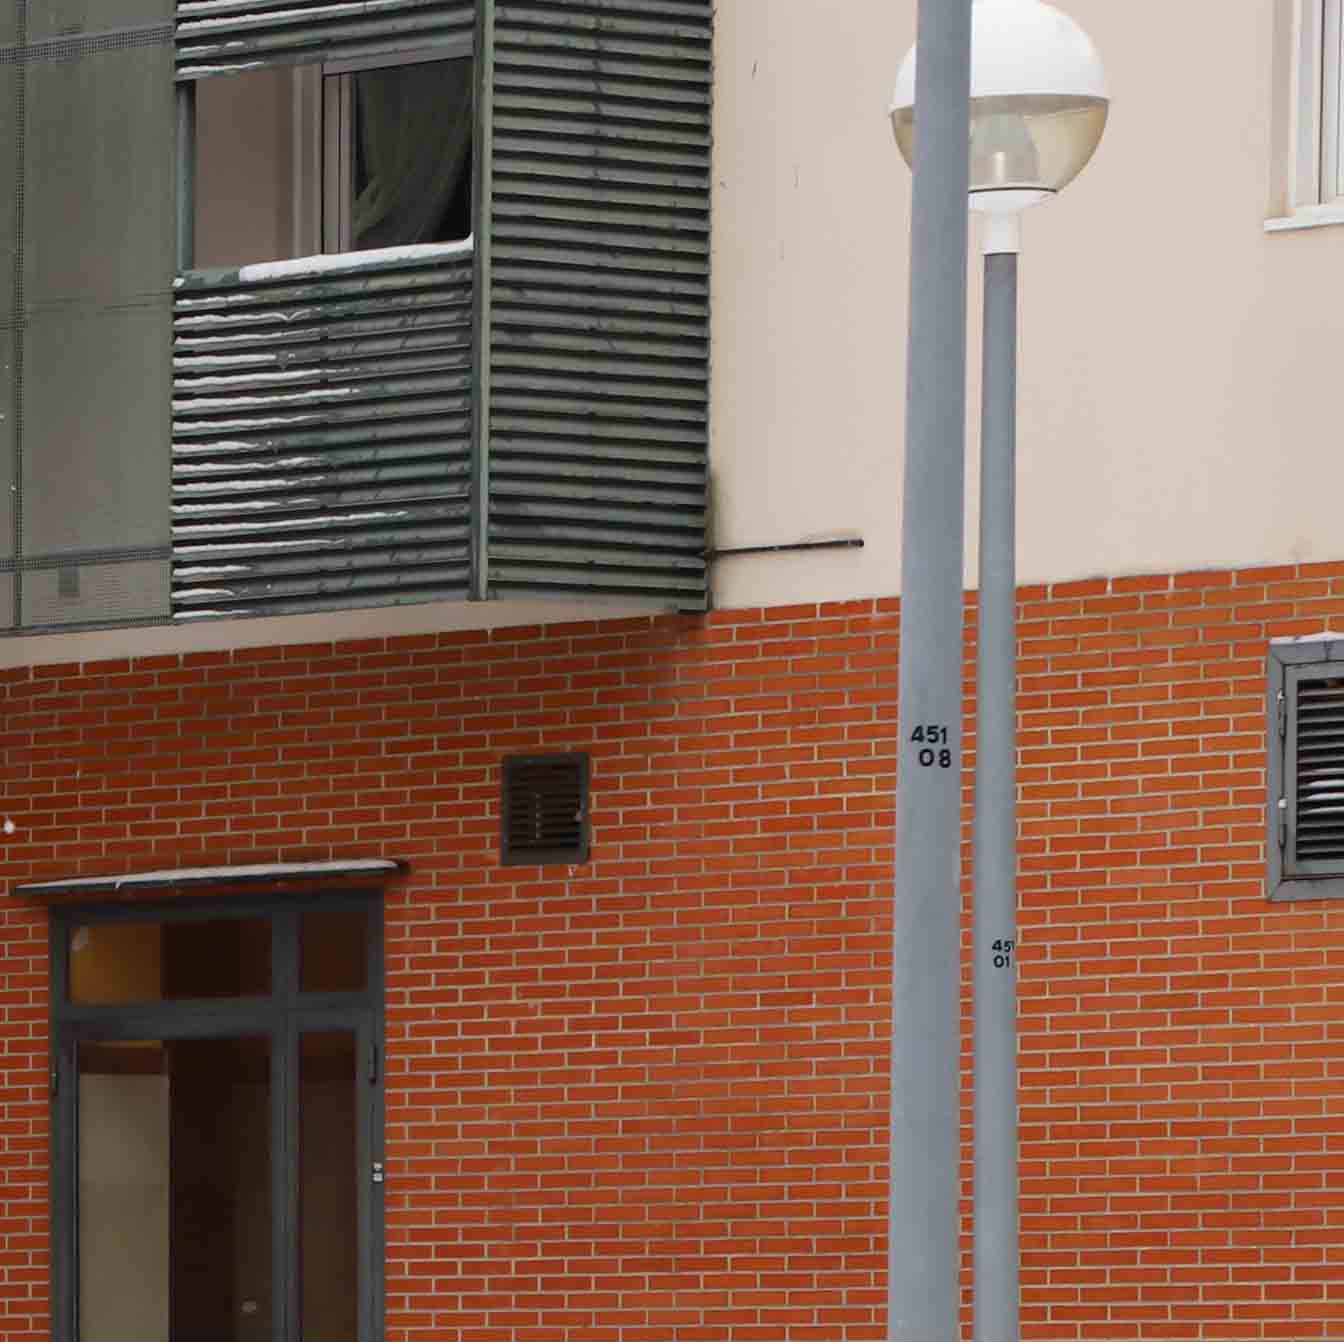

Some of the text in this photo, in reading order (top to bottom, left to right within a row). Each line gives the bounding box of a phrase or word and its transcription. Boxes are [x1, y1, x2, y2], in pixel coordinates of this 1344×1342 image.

[910, 725, 948, 745] 451
[919, 748, 952, 769] 08
[993, 954, 1010, 969] 01
